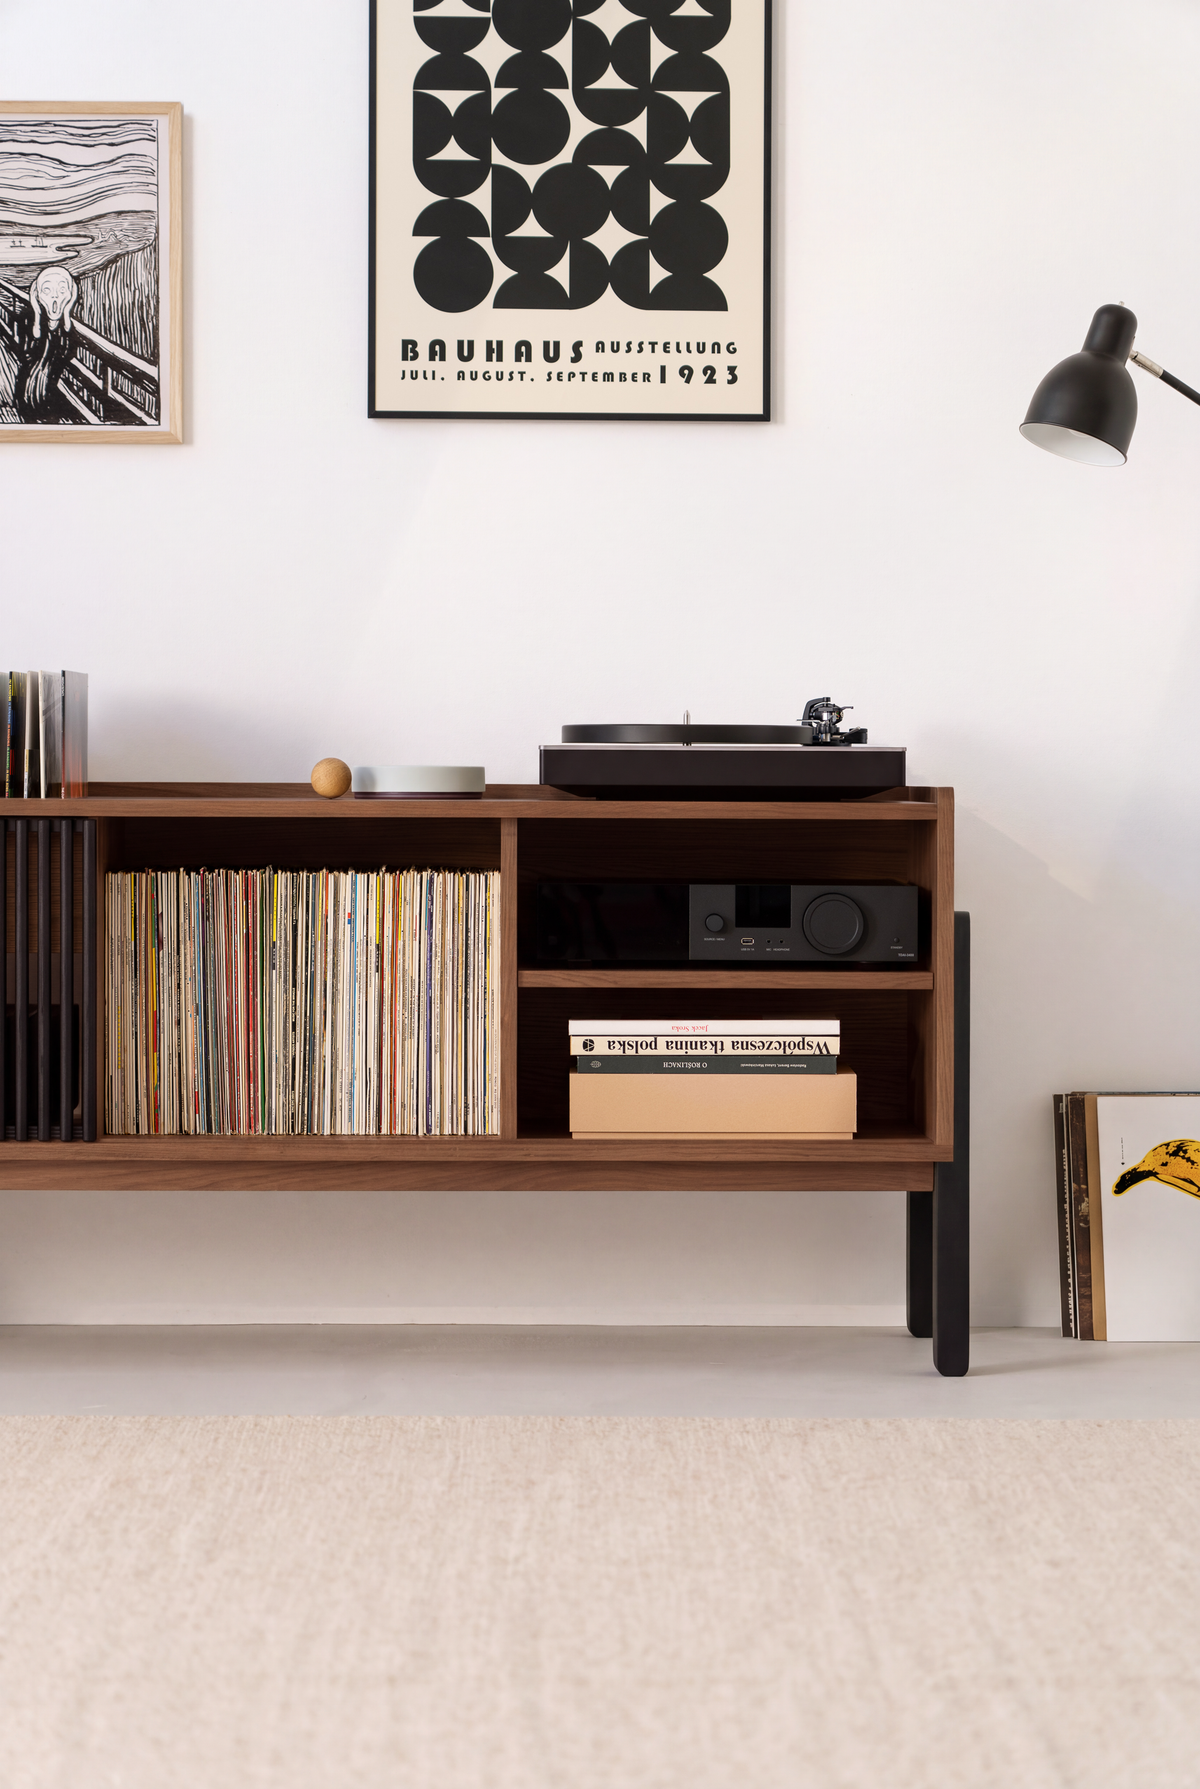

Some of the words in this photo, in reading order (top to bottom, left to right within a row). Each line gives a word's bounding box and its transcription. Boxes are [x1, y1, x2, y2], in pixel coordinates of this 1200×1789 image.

[401, 338, 584, 364] BAUHAUS
[595, 340, 738, 354] AUSSTELLUNG
[400, 369, 445, 382] JULI.
[456, 369, 535, 383] AUGUST.
[546, 370, 652, 383] SEPTEMBER
[659, 364, 739, 385] 1923
[691, 1025, 709, 1033] Jacek
[607, 1037, 658, 1054] polska
[665, 1040, 725, 1054] tkanina
[731, 1036, 831, 1054] Współczesna
[663, 1061, 700, 1069] ROŚLINACH
